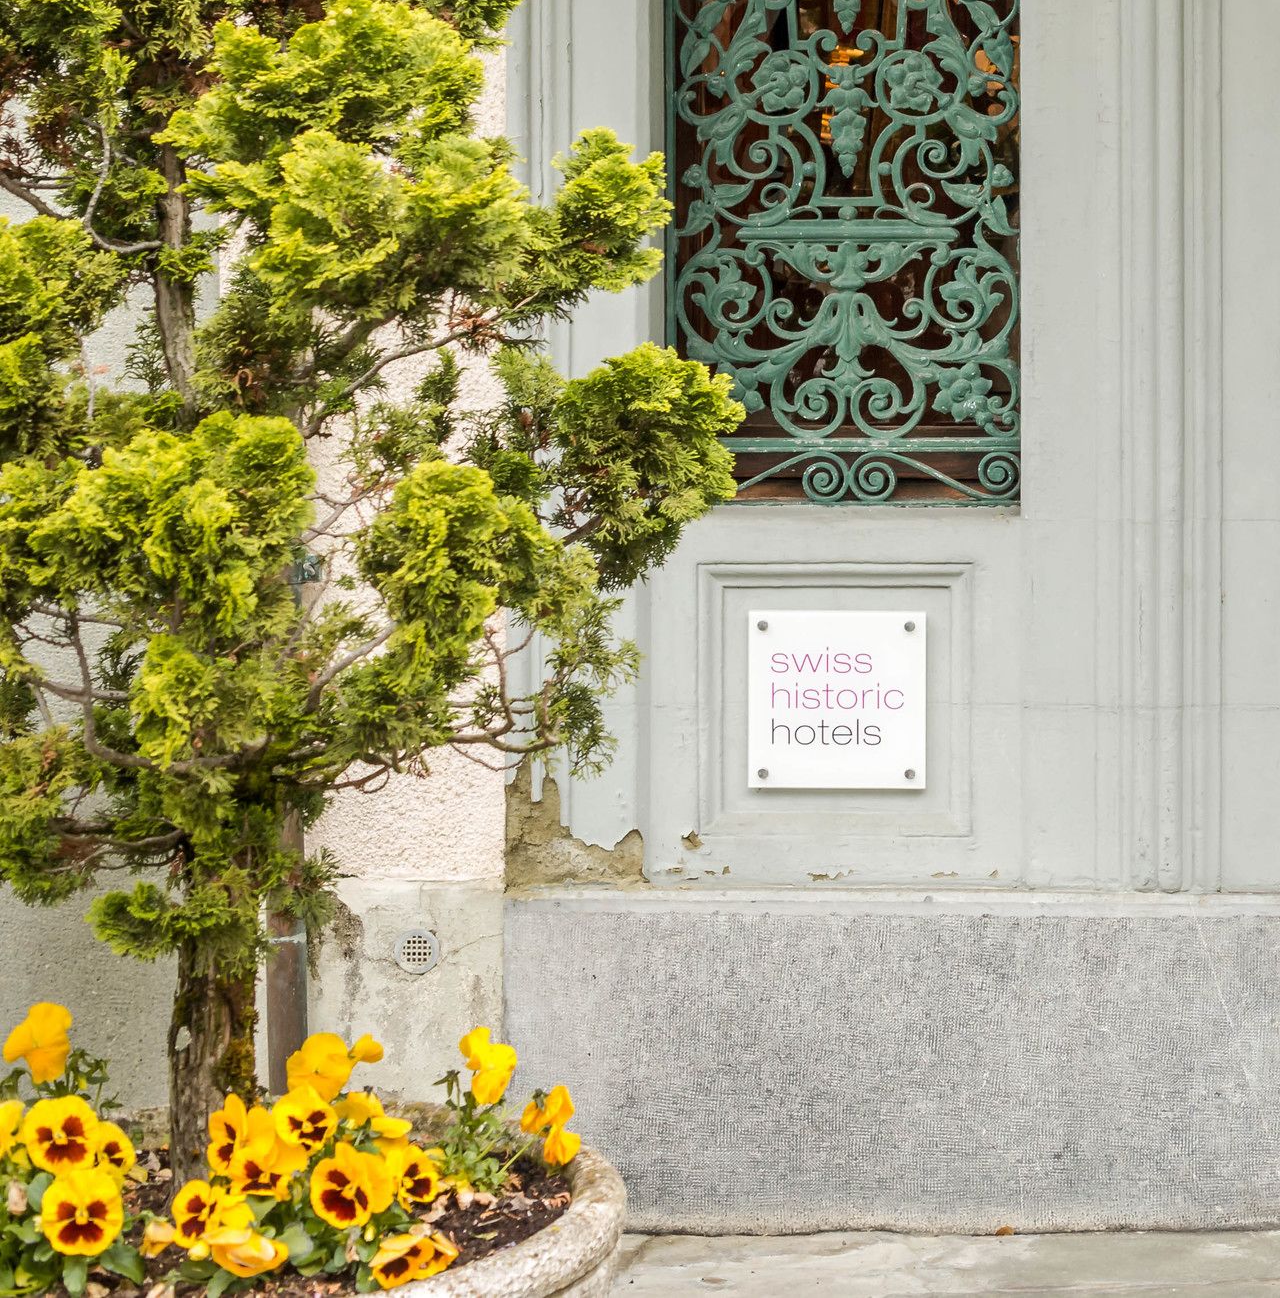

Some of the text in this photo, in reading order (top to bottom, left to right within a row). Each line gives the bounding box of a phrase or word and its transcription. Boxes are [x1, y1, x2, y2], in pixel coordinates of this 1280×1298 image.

[771, 646, 873, 674] swiss
[771, 682, 905, 710] historic
[771, 718, 882, 746] hotels
